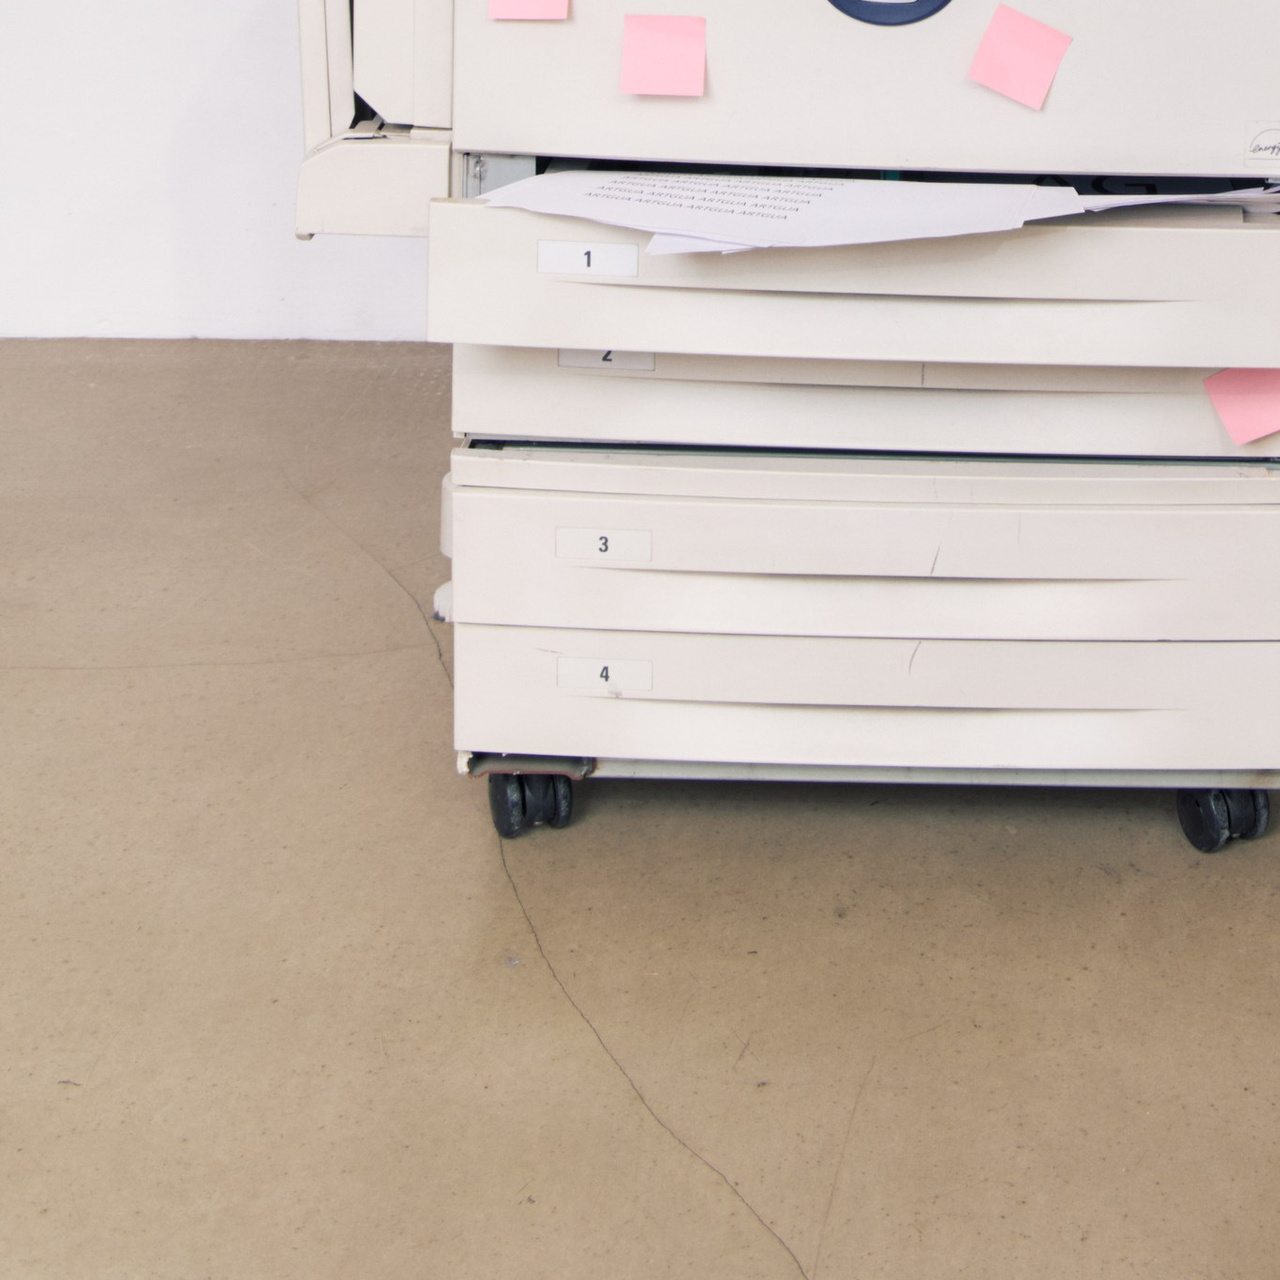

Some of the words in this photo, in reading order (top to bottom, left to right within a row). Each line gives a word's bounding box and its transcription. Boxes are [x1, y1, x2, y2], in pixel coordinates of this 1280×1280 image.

[738, 210, 788, 220] ARTGUA
[584, 250, 592, 268] 1
[598, 535, 609, 553] 3
[599, 665, 610, 682] 4
